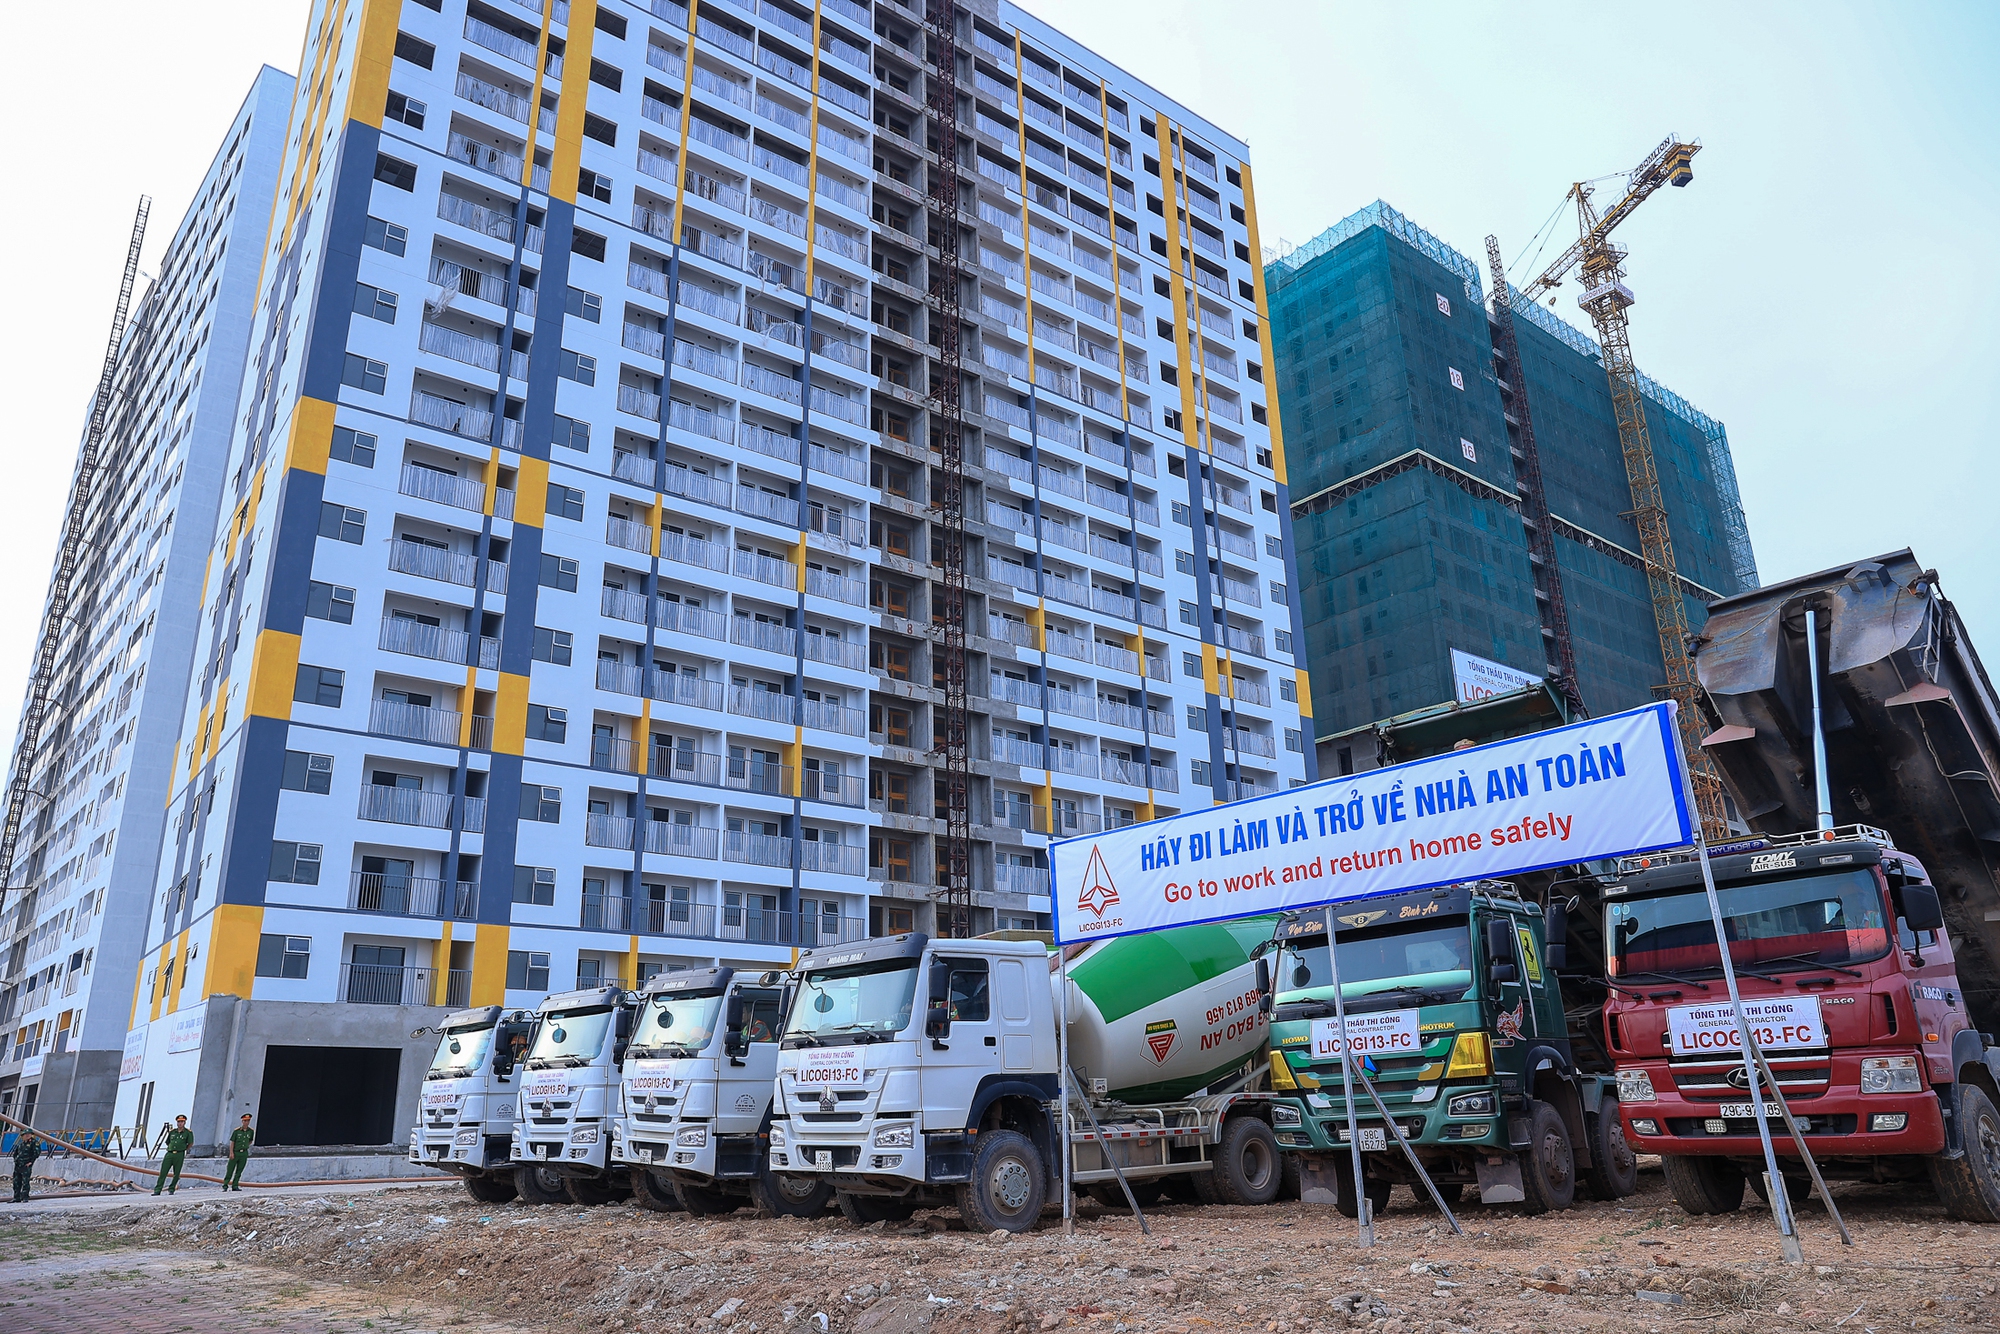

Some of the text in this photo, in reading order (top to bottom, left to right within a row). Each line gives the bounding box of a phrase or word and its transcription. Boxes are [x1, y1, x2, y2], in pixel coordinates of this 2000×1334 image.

[1437, 297, 1449, 313] 20
[1450, 371, 1463, 387] 18
[904, 390, 914, 402] 12
[904, 445, 913, 456] 11
[1462, 443, 1475, 459] 16
[904, 503, 914, 515] 10
[907, 562, 914, 573] 9
[906, 623, 914, 635] 8
[906, 685, 913, 697] 7
[908, 751, 914, 763] 6
[1140, 742, 1628, 872] HÃY ĐI LÀM VÀ TRỞ VỀ NHÀ AN TOÀN
[1710, 842, 1751, 855] HYUNDAI
[1164, 811, 1574, 904] Go to work and return home safely
[1750, 851, 1795, 865] TOMY
[1753, 860, 1795, 871] AIR-SUS
[1399, 900, 1439, 919] Bình An
[1078, 917, 1123, 933] LICOGI13-FC
[1226, 996, 1244, 1016] 813
[1689, 1007, 1715, 1020] TỔNG
[1745, 1006, 1762, 1016] THI
[1764, 1003, 1794, 1014] CÔNG
[1205, 1005, 1225, 1026] 456
[1226, 1015, 1254, 1042] BẢO
[1327, 1020, 1340, 1030] TỔN
[1366, 1018, 1378, 1026] THI
[1380, 1016, 1401, 1025] CÔNG
[1698, 1019, 1733, 1028] GENERAL
[1332, 1025, 1395, 1036] GERAL CONTRACTOR
[1681, 1025, 1812, 1049] LICOG13-FC
[1200, 1029, 1223, 1051] AN
[1281, 1035, 1309, 1045] HOWO
[800, 1068, 859, 1082] LICOGI13-FC
[634, 1077, 671, 1089] LICOGI13-FC
[1363, 1130, 1379, 1140] 98C
